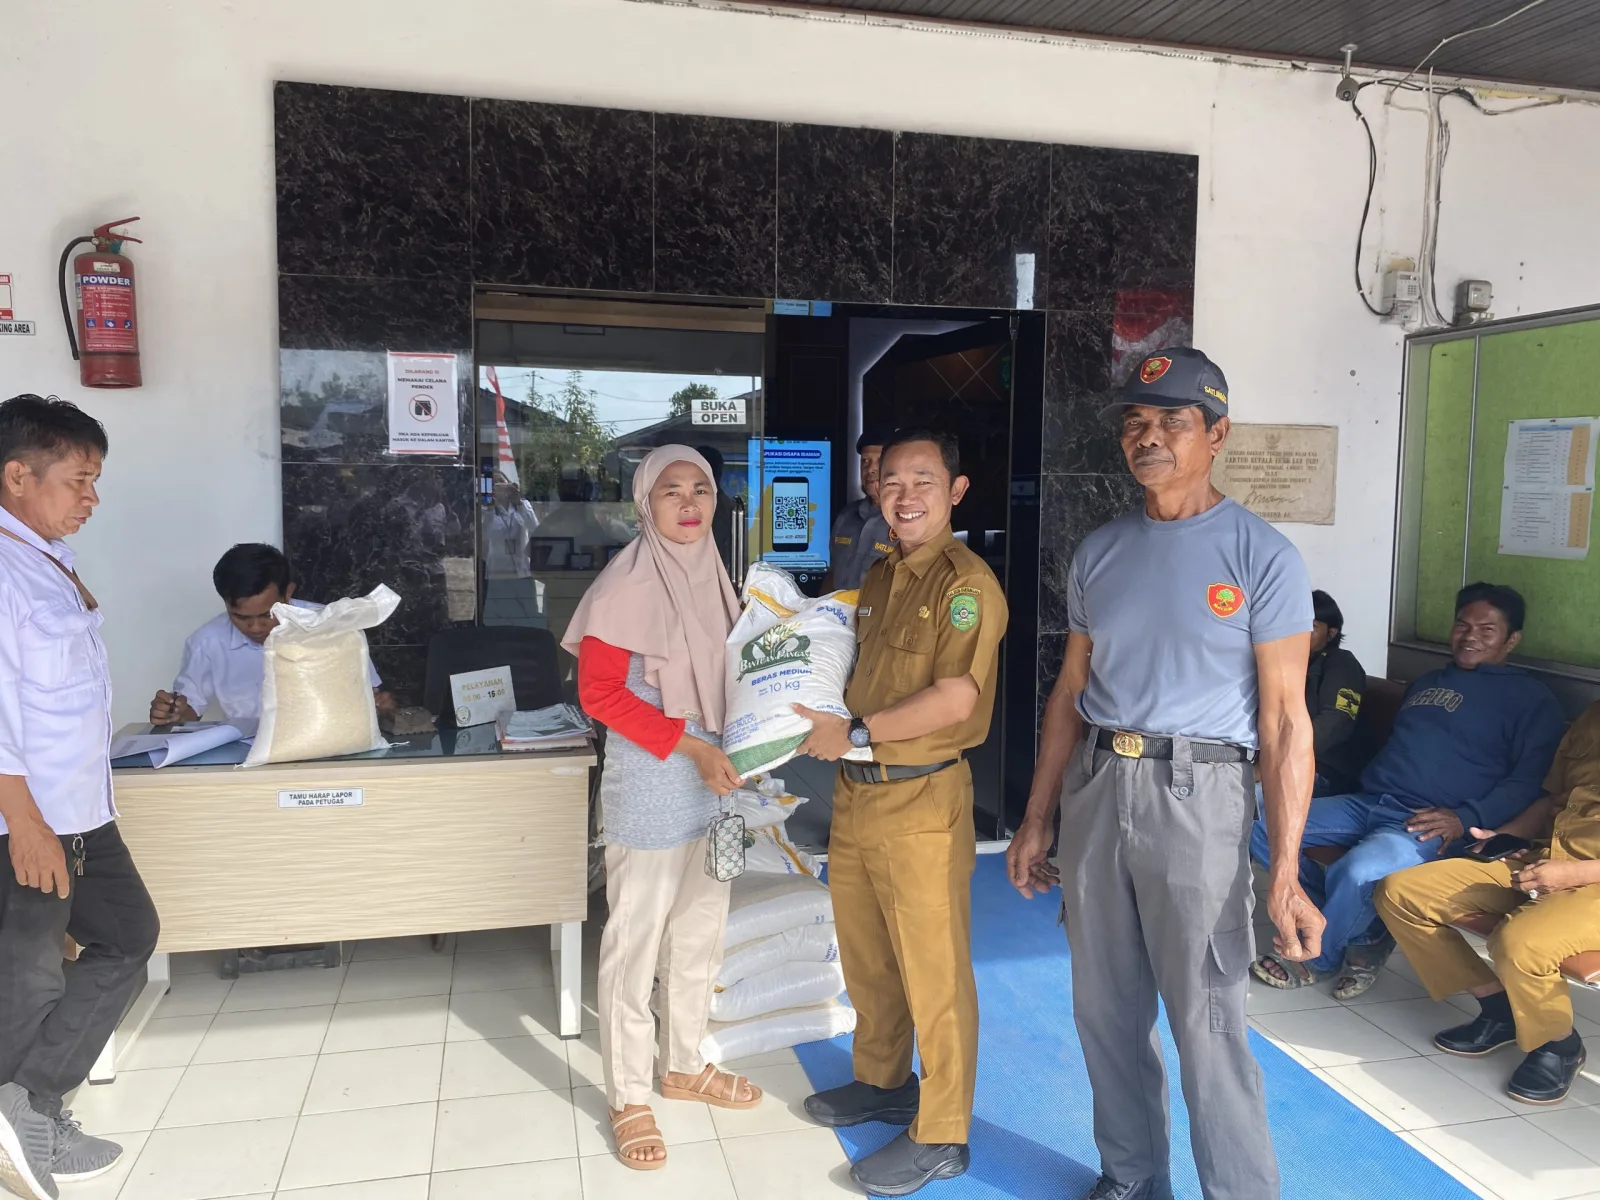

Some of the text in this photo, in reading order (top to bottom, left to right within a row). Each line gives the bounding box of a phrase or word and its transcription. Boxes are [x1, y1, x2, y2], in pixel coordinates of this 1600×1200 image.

[82, 276, 131, 286] POWDER
[14, 323, 30, 334] AREA
[700, 401, 737, 411] BUKA
[701, 413, 738, 423] OPEN
[825, 605, 848, 626] bulog
[461, 678, 503, 691] PELAYANAN
[751, 672, 778, 687] BERAS
[769, 683, 782, 693] 10
[785, 680, 801, 691] kg
